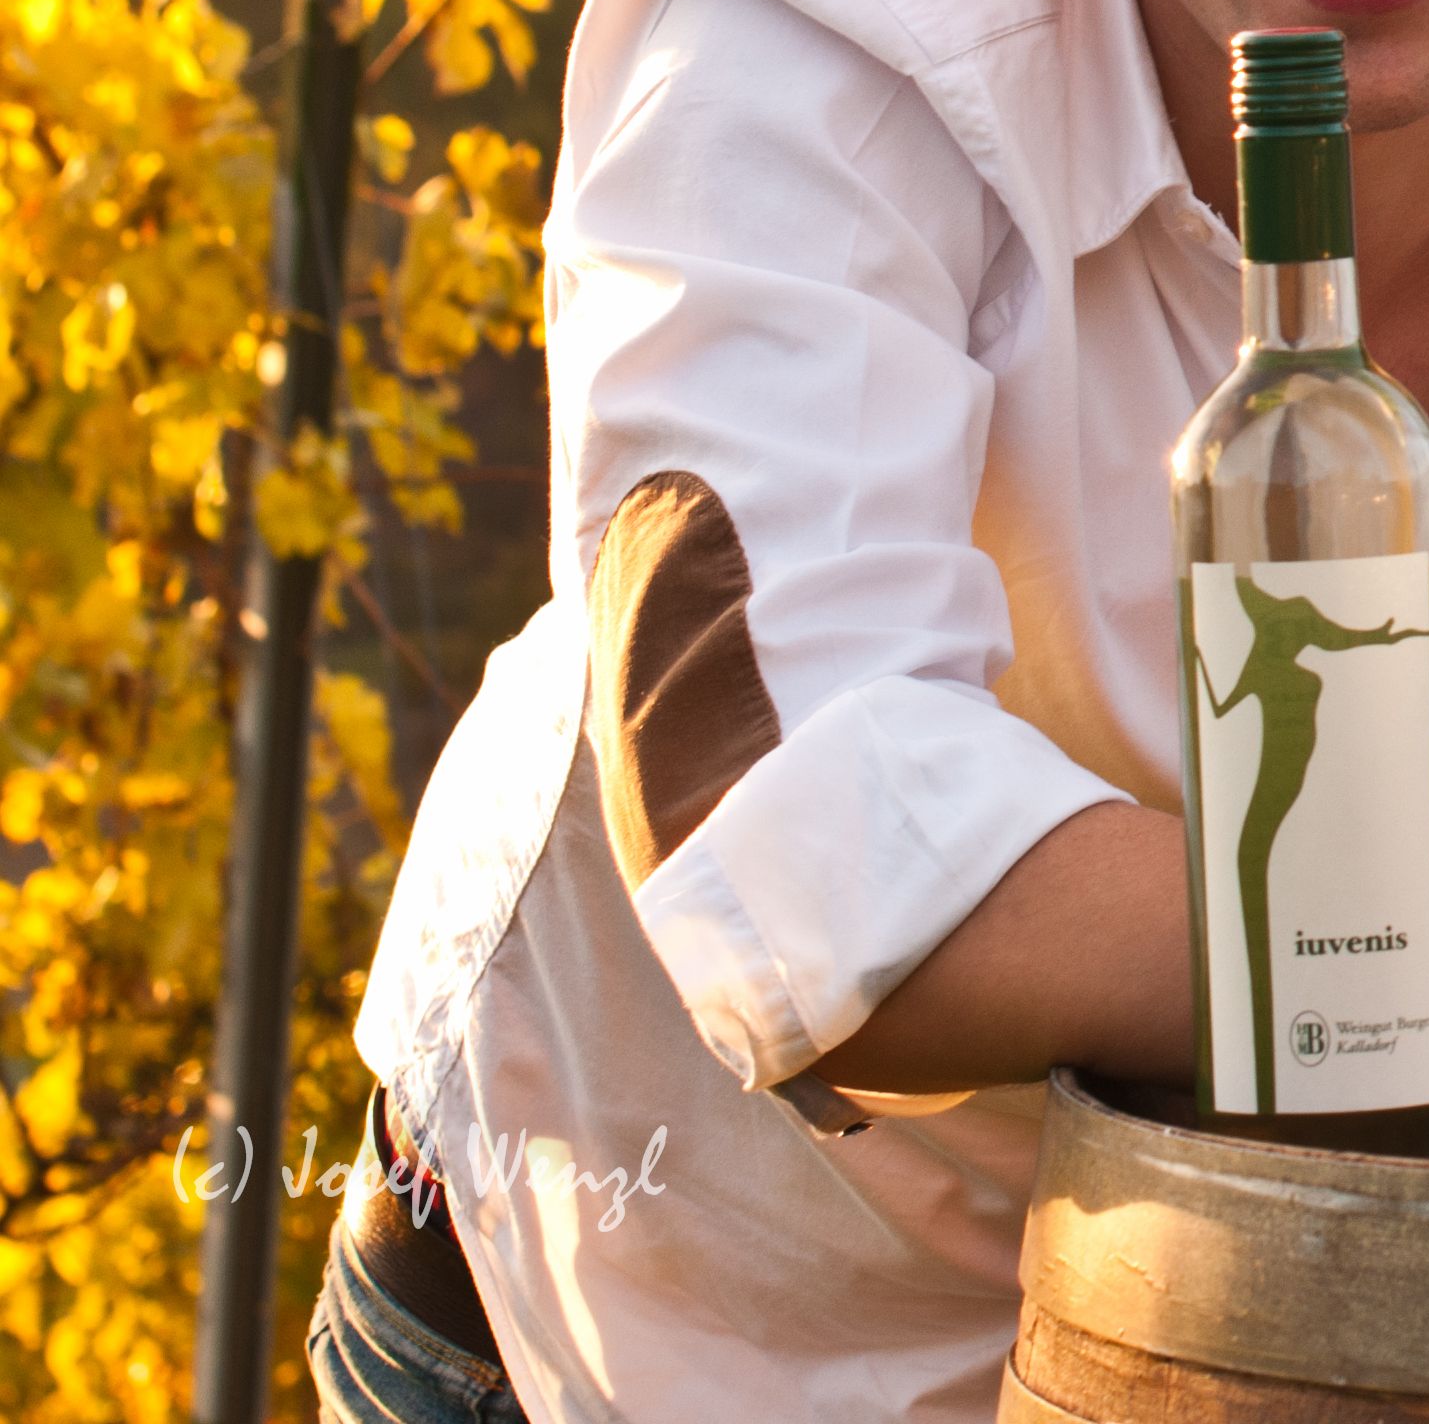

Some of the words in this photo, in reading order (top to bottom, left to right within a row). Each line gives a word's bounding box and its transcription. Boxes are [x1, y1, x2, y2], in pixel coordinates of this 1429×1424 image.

[1295, 925, 1409, 956] iuvenis
[1335, 1021, 1393, 1037] Weingut
[1335, 1035, 1399, 1055] Kalladorf
